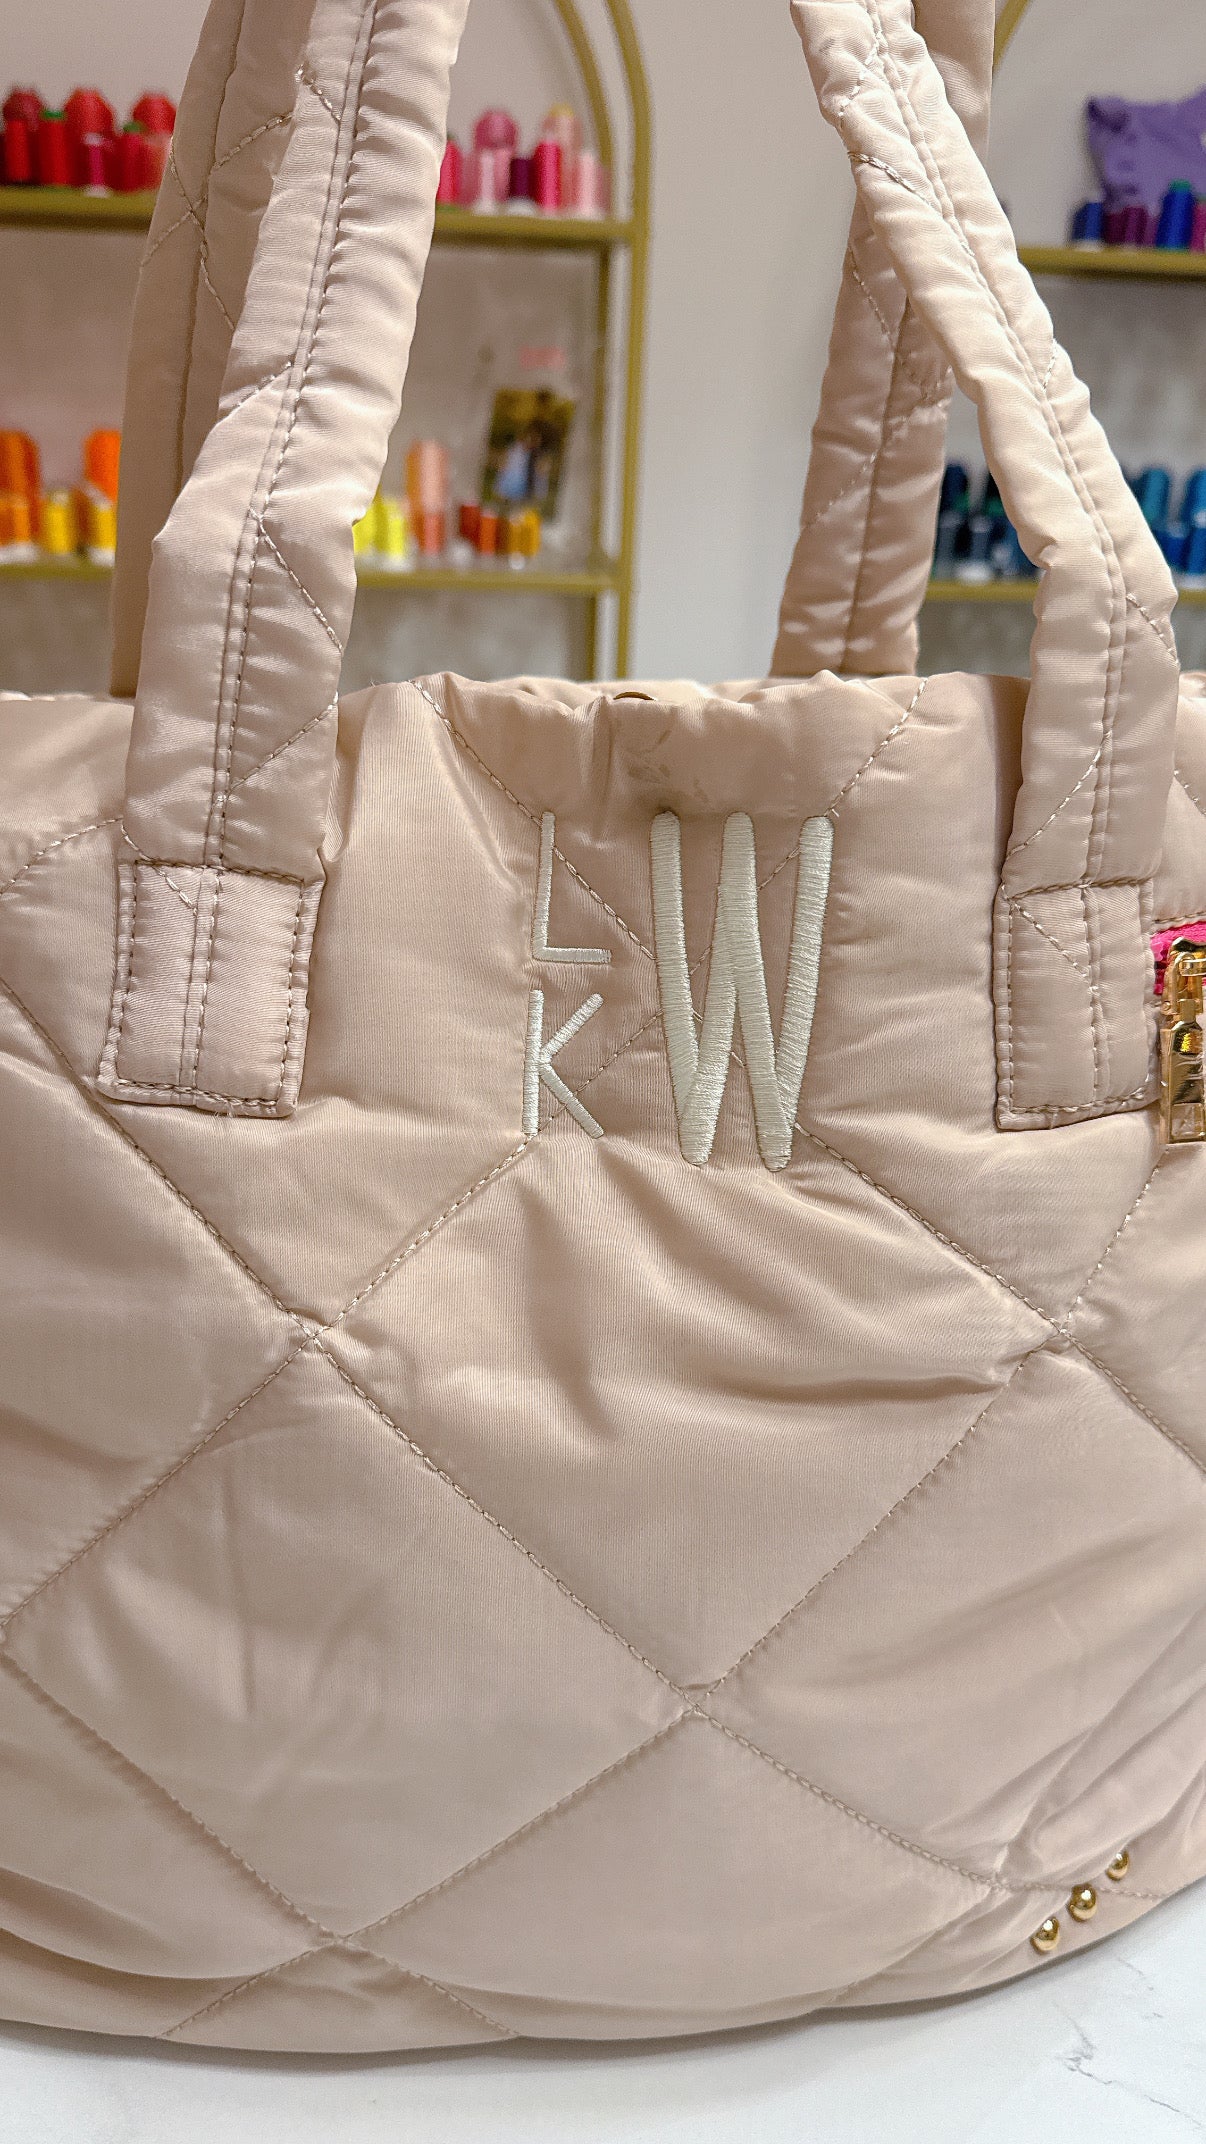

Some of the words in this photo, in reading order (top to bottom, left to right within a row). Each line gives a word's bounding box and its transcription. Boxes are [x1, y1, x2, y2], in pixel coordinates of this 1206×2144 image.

[532, 811, 612, 964] L
[521, 989, 604, 1139] K
[649, 811, 835, 1172] W
